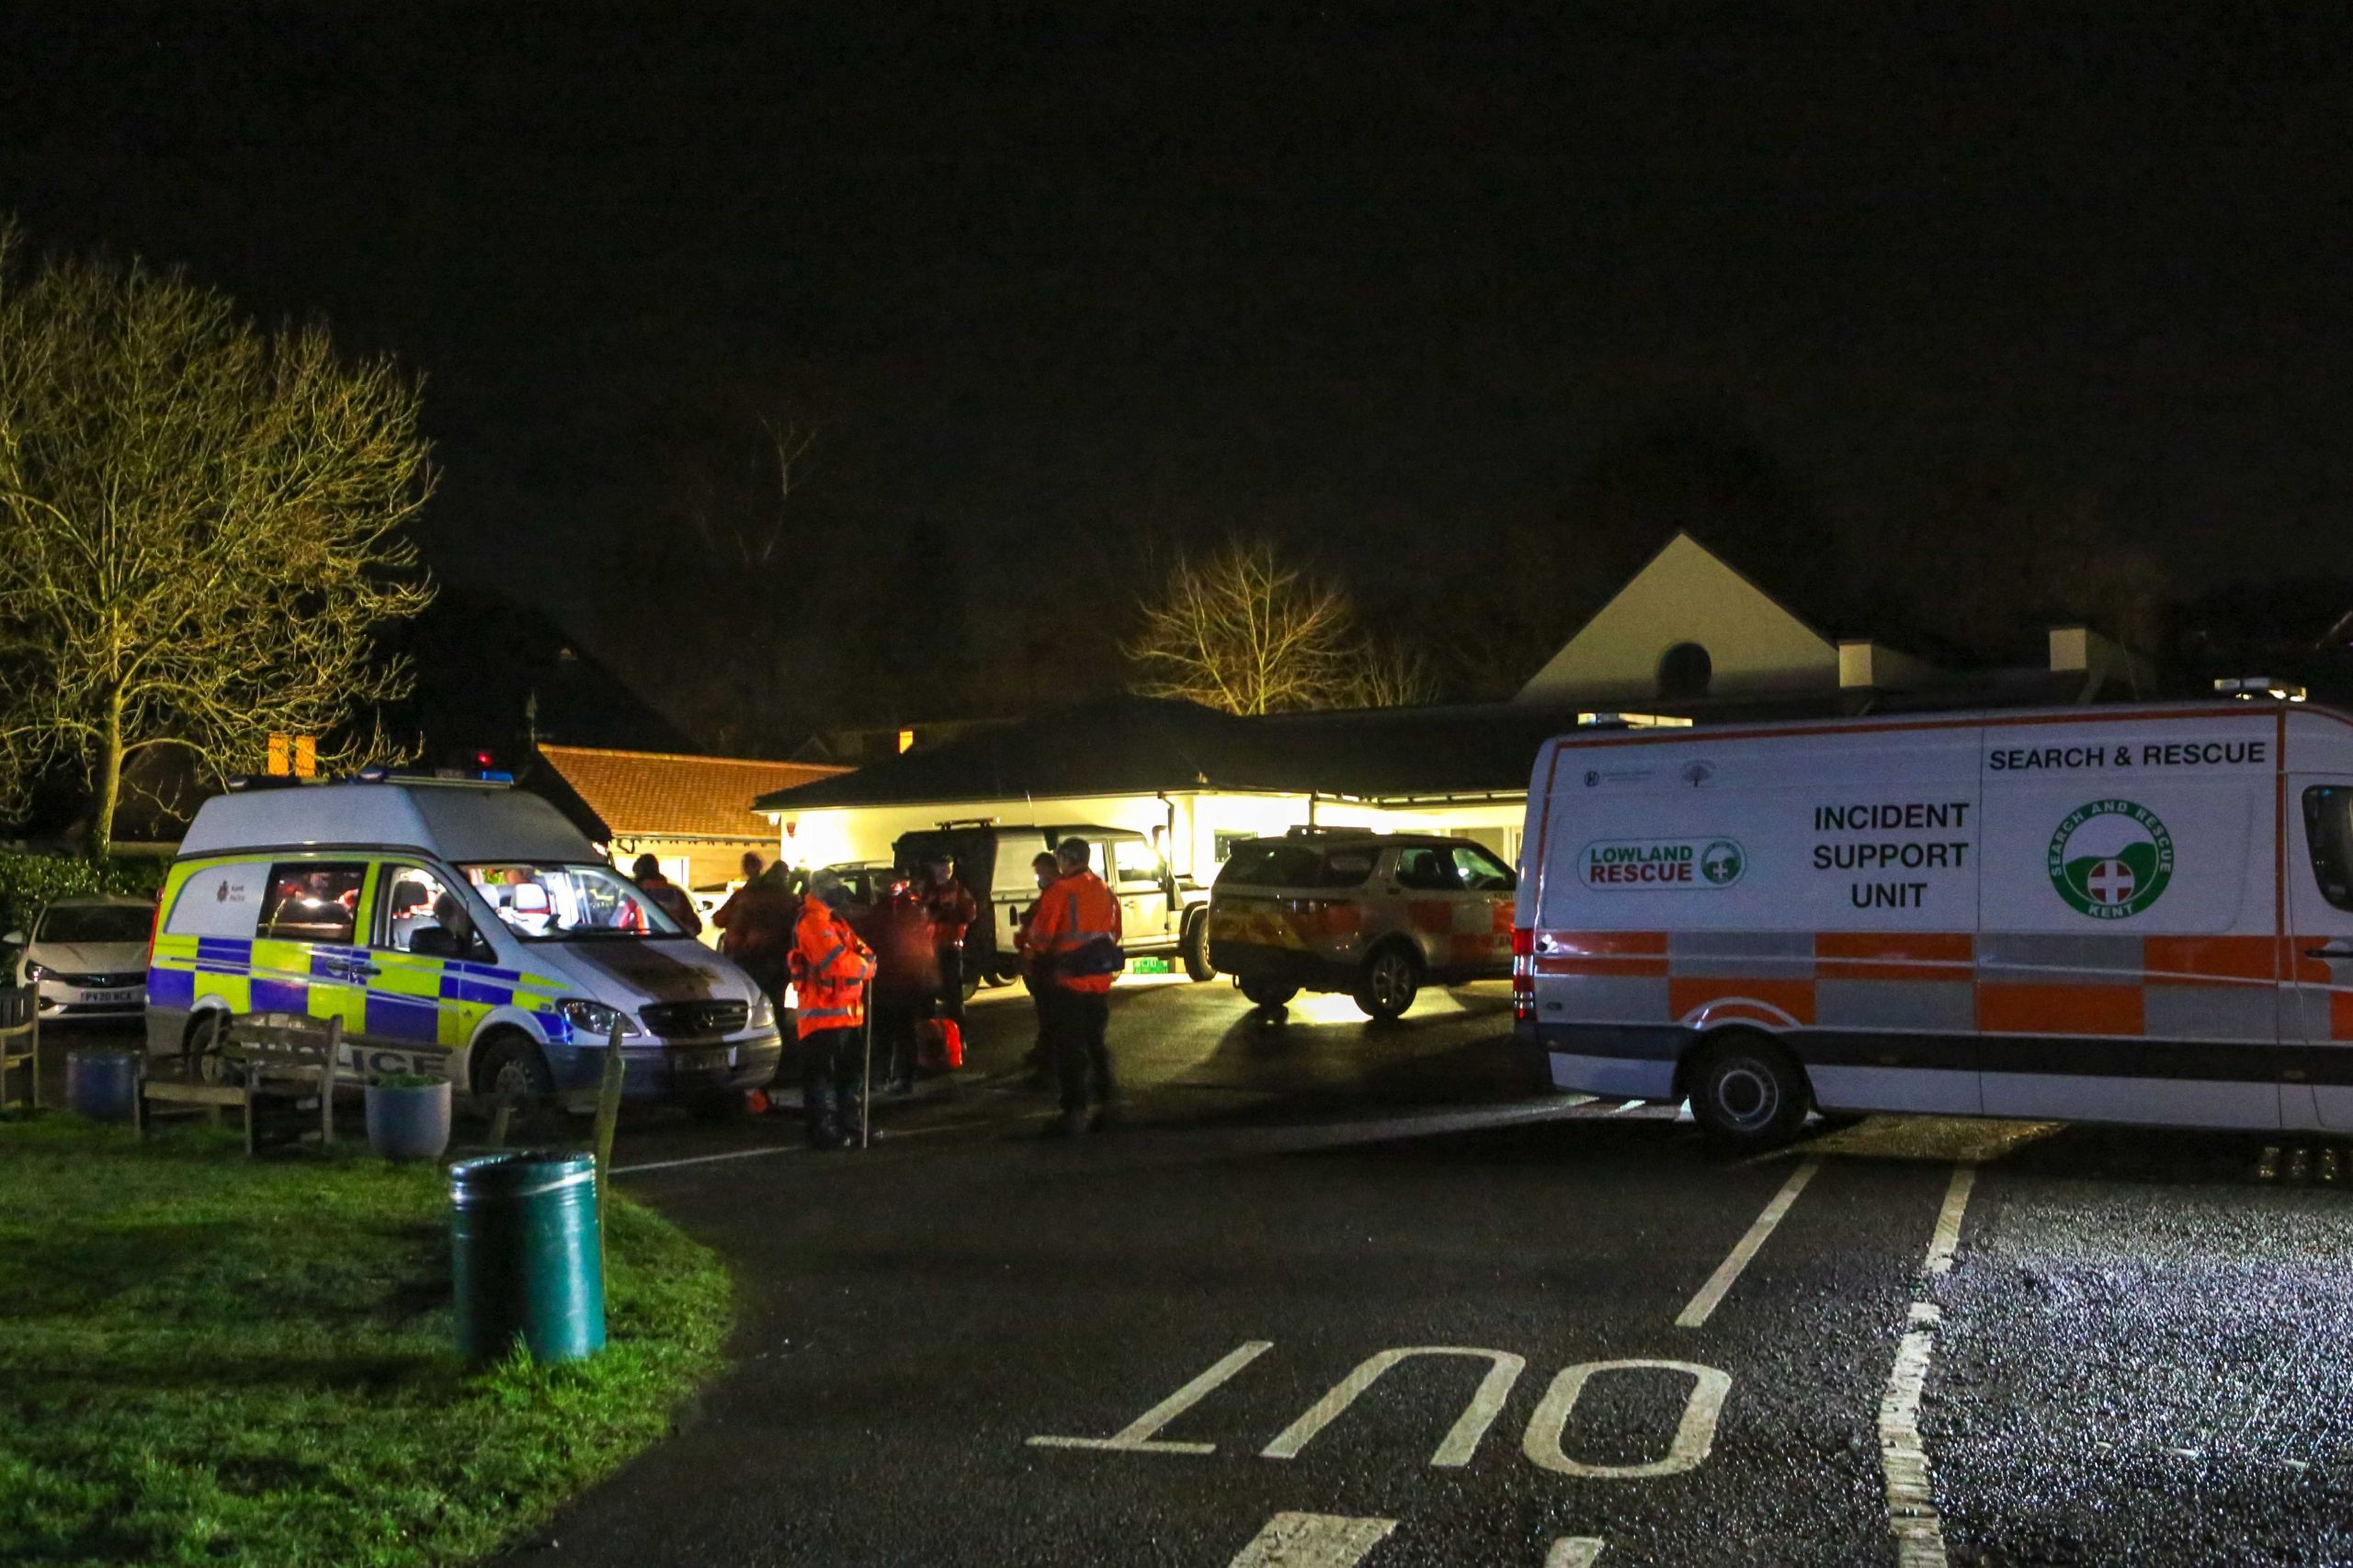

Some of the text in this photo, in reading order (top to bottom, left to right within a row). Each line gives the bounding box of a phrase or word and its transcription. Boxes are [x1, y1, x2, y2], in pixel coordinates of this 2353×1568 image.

[1989, 742, 2266, 770] SEARCH & RESCUE
[1814, 802, 1970, 830] INCIDENT
[2051, 801, 2172, 877] SEARCH AND RESCUE
[1590, 846, 1693, 863] LOWLAND
[1813, 842, 1969, 869] SUPPORT
[1590, 863, 1692, 883] RESCUE
[1852, 882, 1927, 908] UNIT
[2088, 903, 2133, 917] KENT
[1024, 1340, 1733, 1478] OUT
